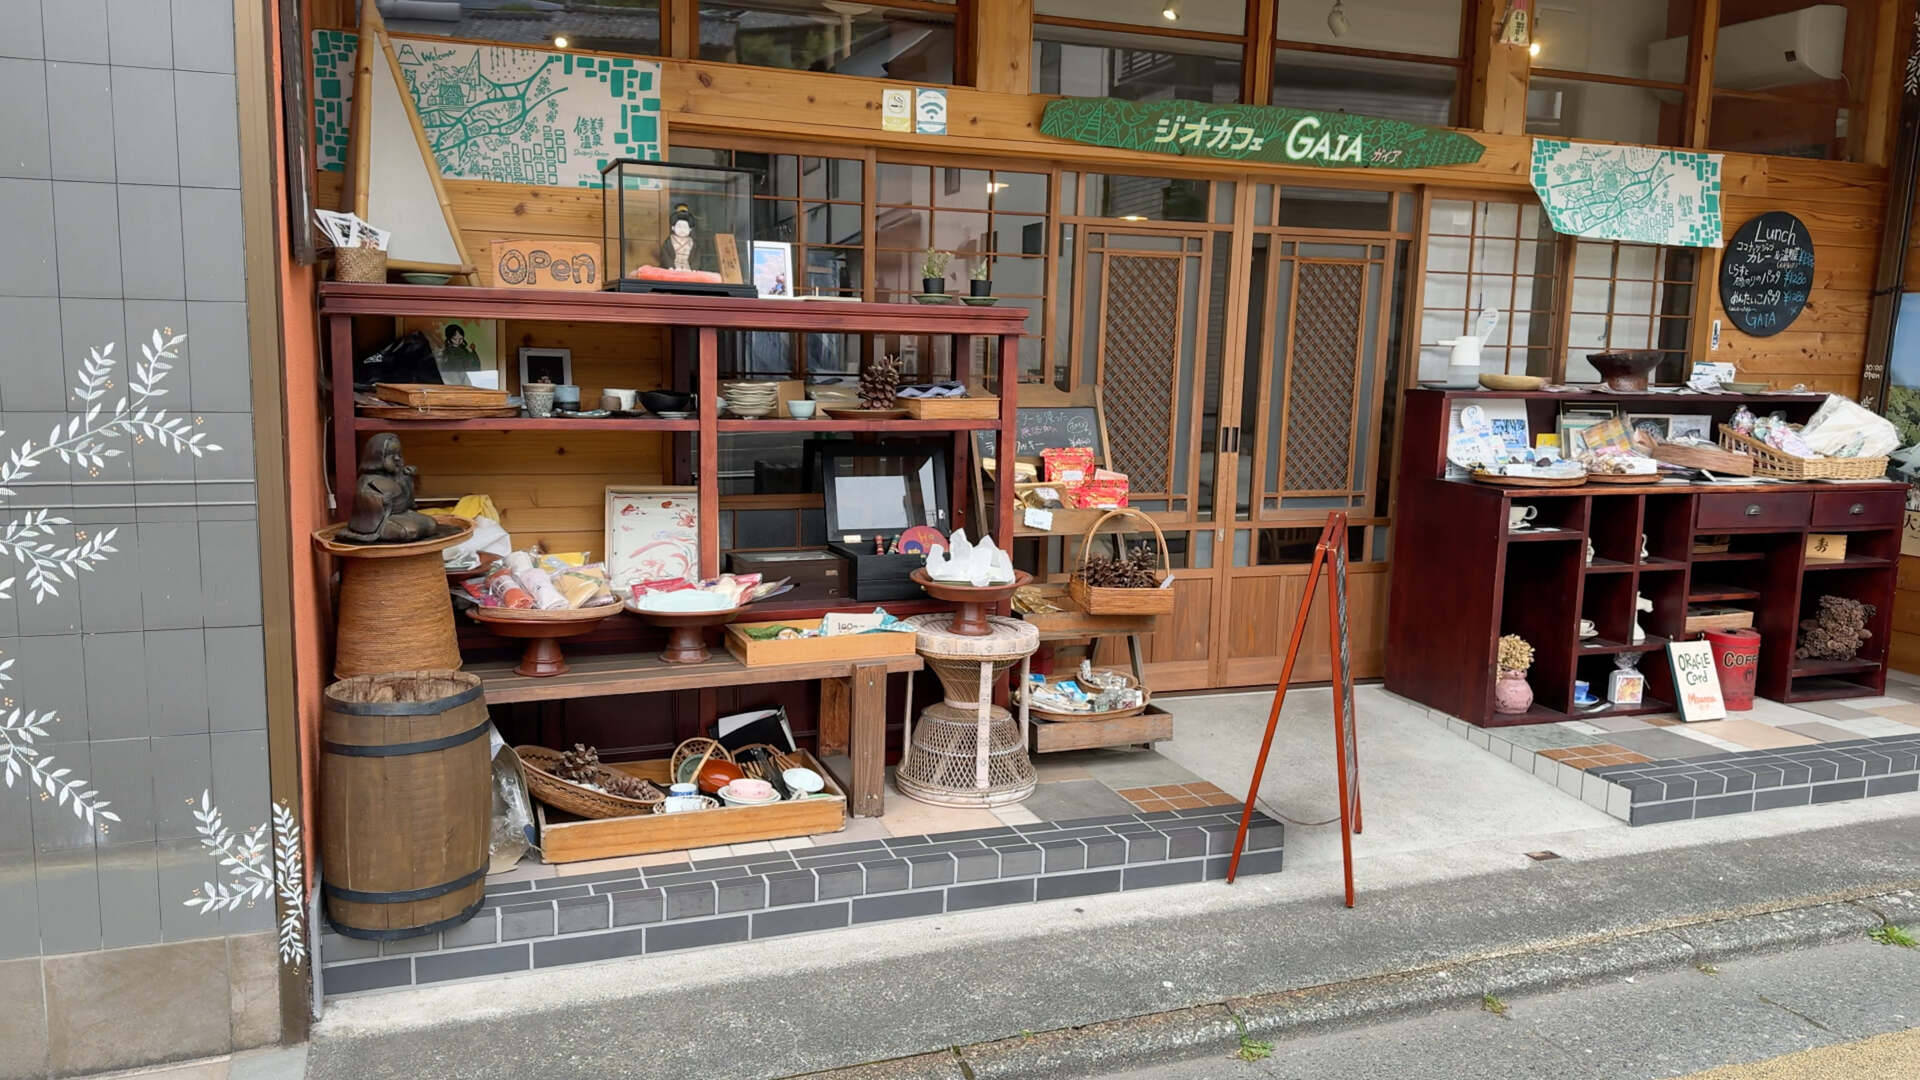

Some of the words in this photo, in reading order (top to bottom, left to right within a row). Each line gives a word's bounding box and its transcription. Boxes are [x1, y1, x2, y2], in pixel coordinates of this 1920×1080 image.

[421, 46, 456, 63] Welcome
[1155, 115, 1264, 151] ジオカフェ
[1285, 116, 1363, 163] GAIA
[1371, 149, 1402, 163] ガイア
[1755, 219, 1797, 246] Lunch
[1678, 652, 1711, 672] ORACLE
[1686, 671, 1708, 686] Card
